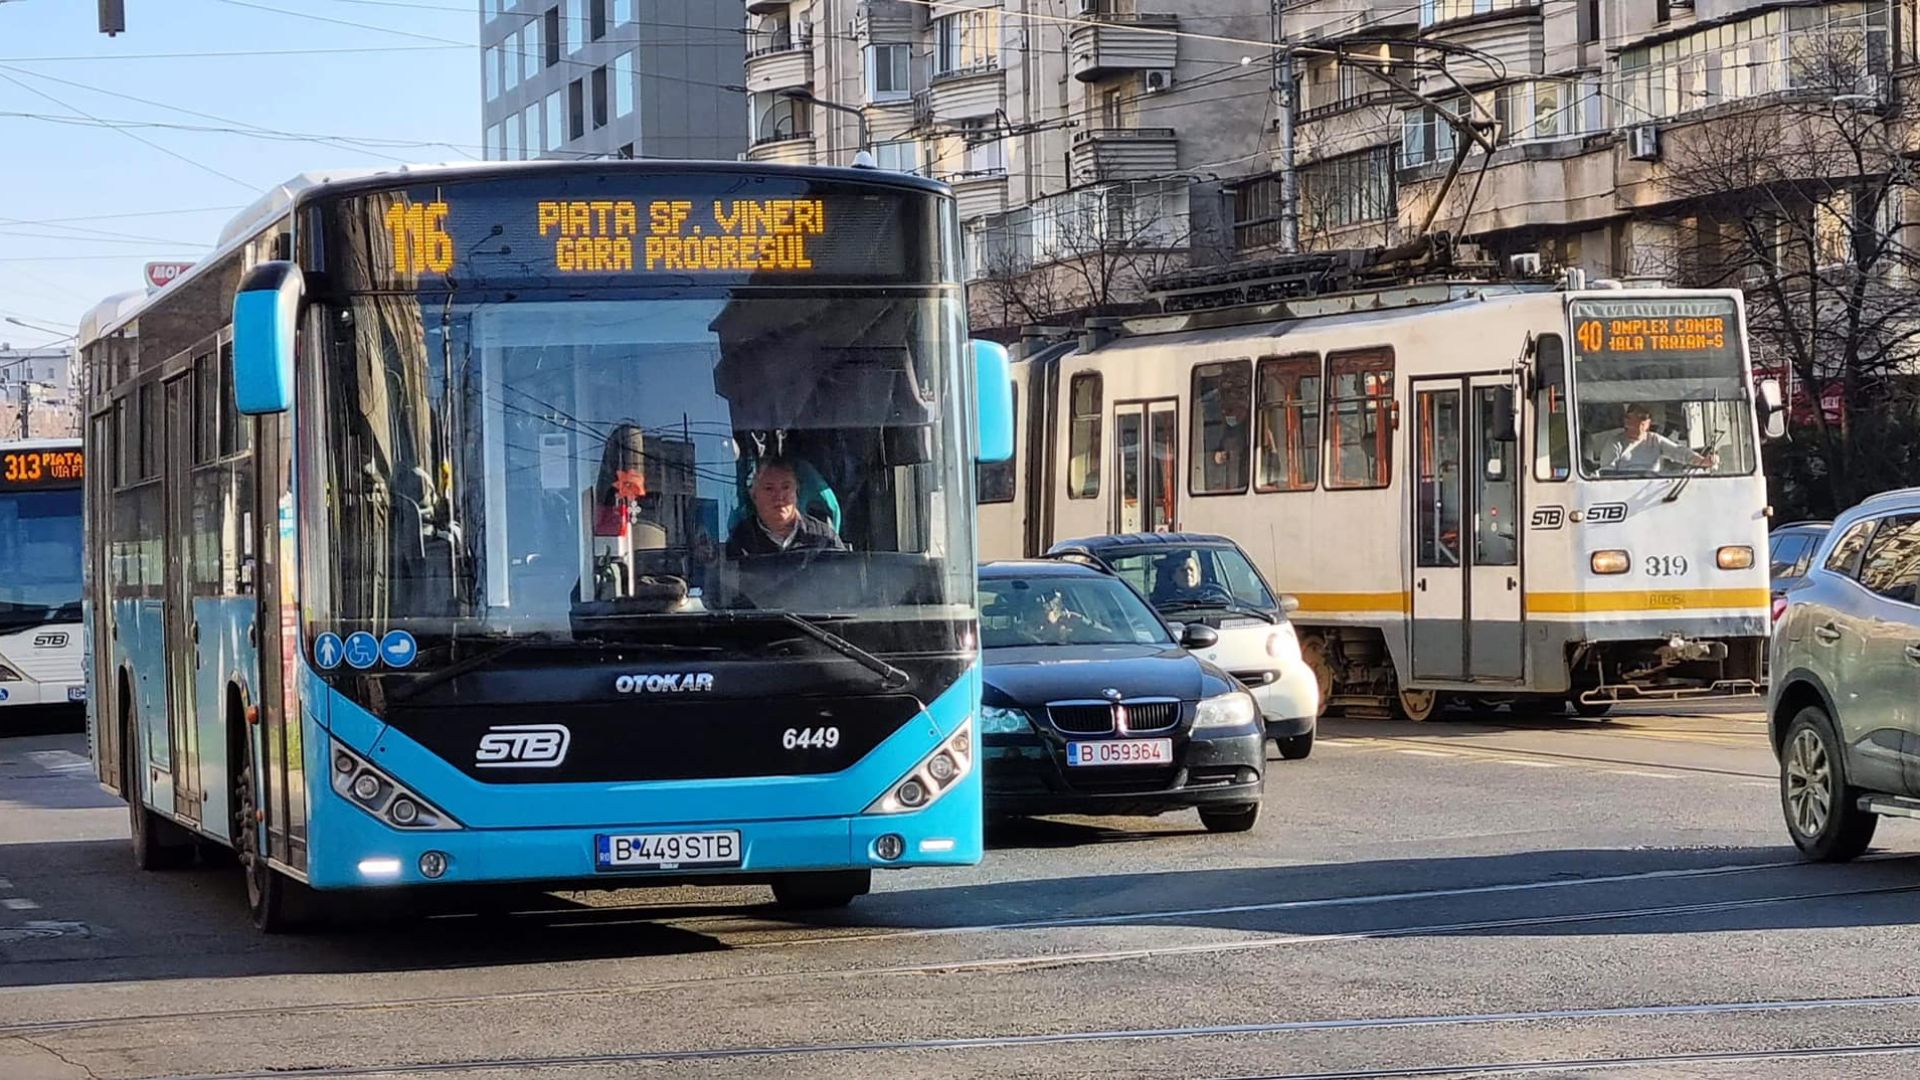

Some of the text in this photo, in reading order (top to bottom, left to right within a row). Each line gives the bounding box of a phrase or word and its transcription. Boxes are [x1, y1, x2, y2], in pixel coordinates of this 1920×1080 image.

[538, 200, 824, 236] PIATA SF. VINERI
[384, 202, 454, 273] 116
[556, 235, 813, 271] GARA PROGRESUL
[1577, 320, 1603, 352] 40
[1608, 317, 1724, 335] OMPLEX COMER
[4, 452, 42, 480] 313
[42, 452, 83, 466] PIATA
[51, 465, 70, 478] VIA
[1531, 507, 1563, 528] STB
[1586, 504, 1625, 523] STB
[1645, 554, 1689, 577] 319
[33, 633, 68, 647] STB
[615, 673, 714, 694] OTOKAR
[476, 728, 566, 764] STB
[782, 727, 840, 749] 6449
[1081, 744, 1094, 762] B
[1100, 743, 1161, 761] 059364
[615, 835, 732, 861] B 449 STB
